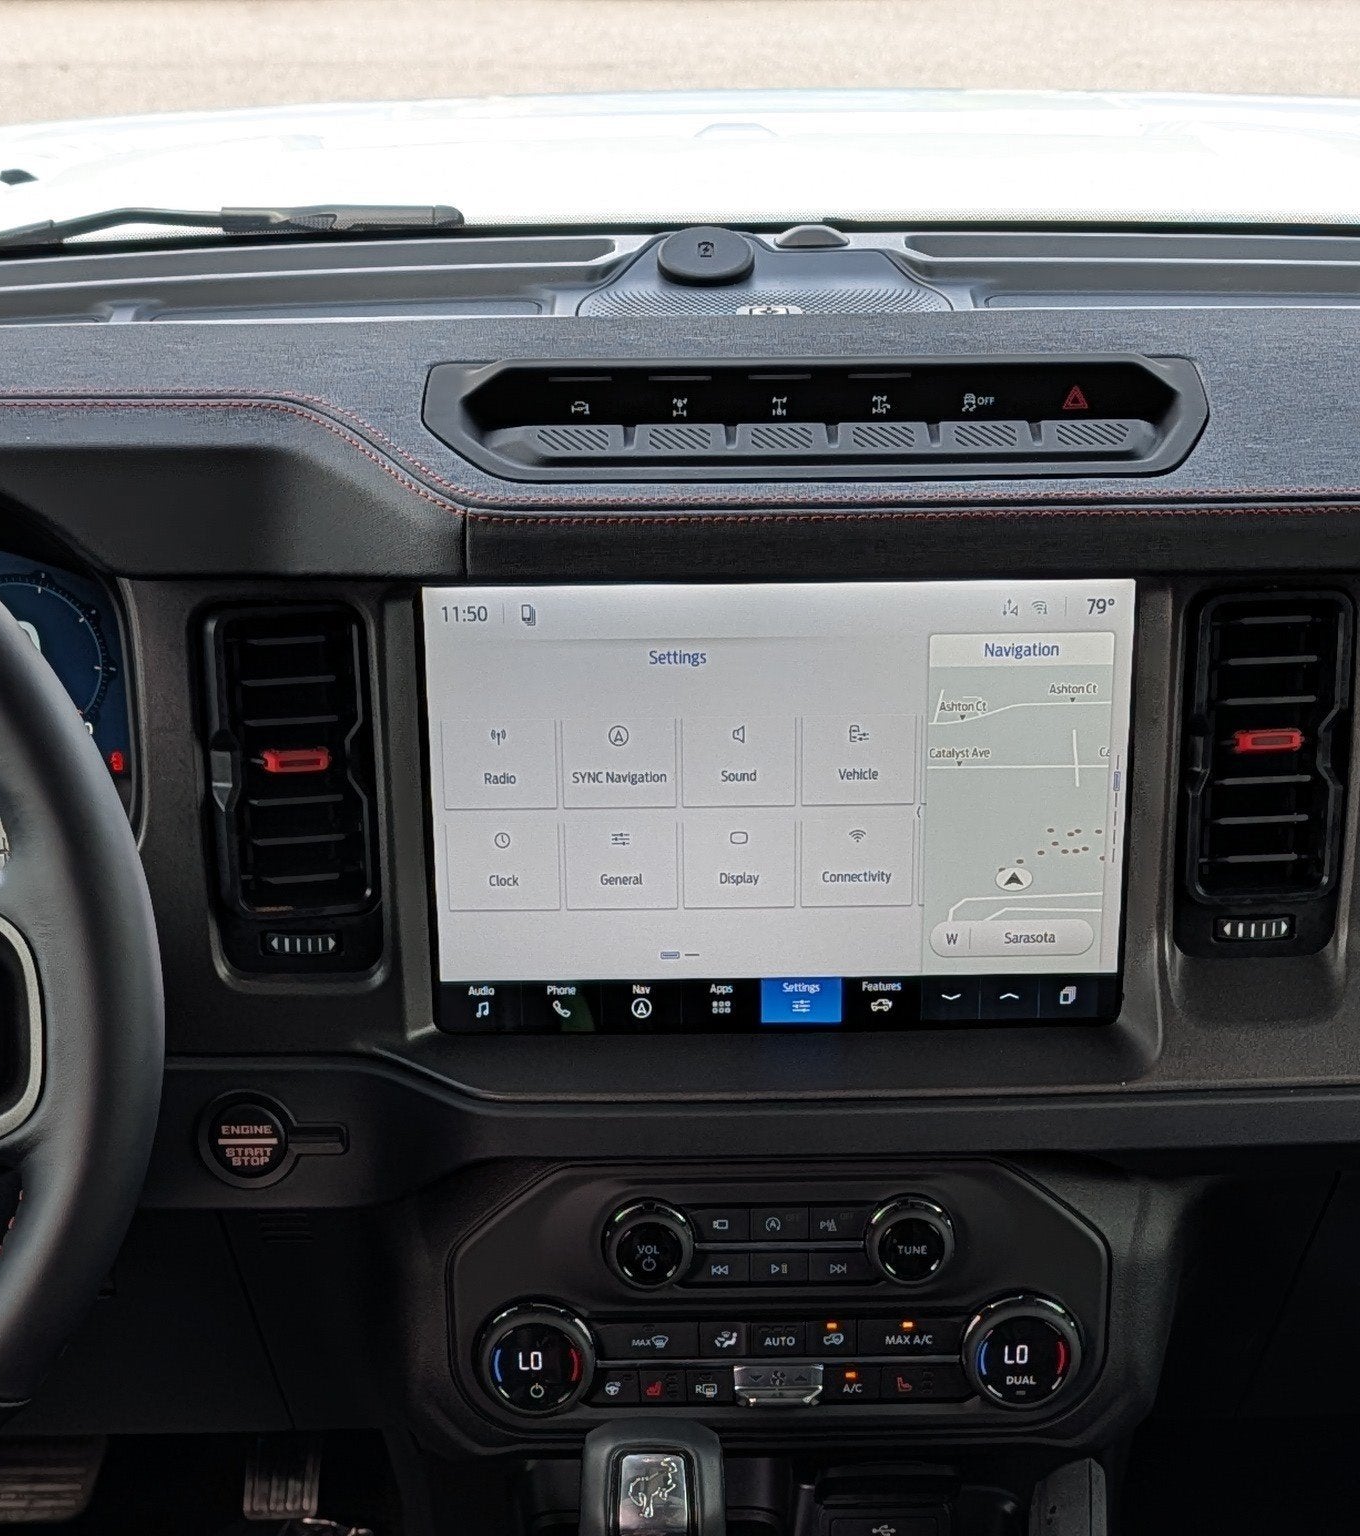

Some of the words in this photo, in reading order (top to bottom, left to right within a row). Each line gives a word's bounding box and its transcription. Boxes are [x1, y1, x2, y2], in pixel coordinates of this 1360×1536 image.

[977, 396, 995, 406] OFF
[1087, 598, 1115, 615] 79°
[441, 605, 488, 623] 11:50
[984, 642, 1060, 660] Navigation
[649, 650, 707, 667] Settings
[1049, 683, 1084, 694] Ashton
[1085, 683, 1098, 694] Ct
[939, 701, 975, 712] Ashton
[975, 701, 987, 712] Ct
[929, 747, 969, 760] Catalyst
[970, 747, 991, 759] Ave
[484, 772, 516, 785] Radio
[572, 771, 603, 784] SYNC
[605, 770, 667, 786] Navigation
[721, 770, 757, 783] Sound
[838, 768, 879, 781] Vehicle
[489, 874, 519, 887] Clock
[600, 873, 643, 886] General
[719, 872, 759, 886] Display
[822, 870, 892, 884] Connectivity
[946, 932, 958, 945] W
[1004, 931, 1056, 944] Sarasota
[468, 985, 495, 996] Audio
[547, 985, 576, 996] Phone
[632, 984, 651, 995] Nav
[709, 984, 734, 996] Apps
[782, 982, 821, 994] Settings
[862, 981, 902, 992] Features
[221, 1125, 273, 1135] ENGINE
[225, 1147, 273, 1158] START
[232, 1156, 270, 1167] STOP
[637, 1244, 660, 1255] VOL
[897, 1244, 928, 1255] TUNE
[632, 1338, 651, 1347] MAX
[764, 1336, 795, 1347] AUTO
[885, 1334, 910, 1345] MAX
[912, 1334, 933, 1345] A/C
[1005, 1375, 1037, 1385] DUAL
[843, 1382, 862, 1394] A/C
